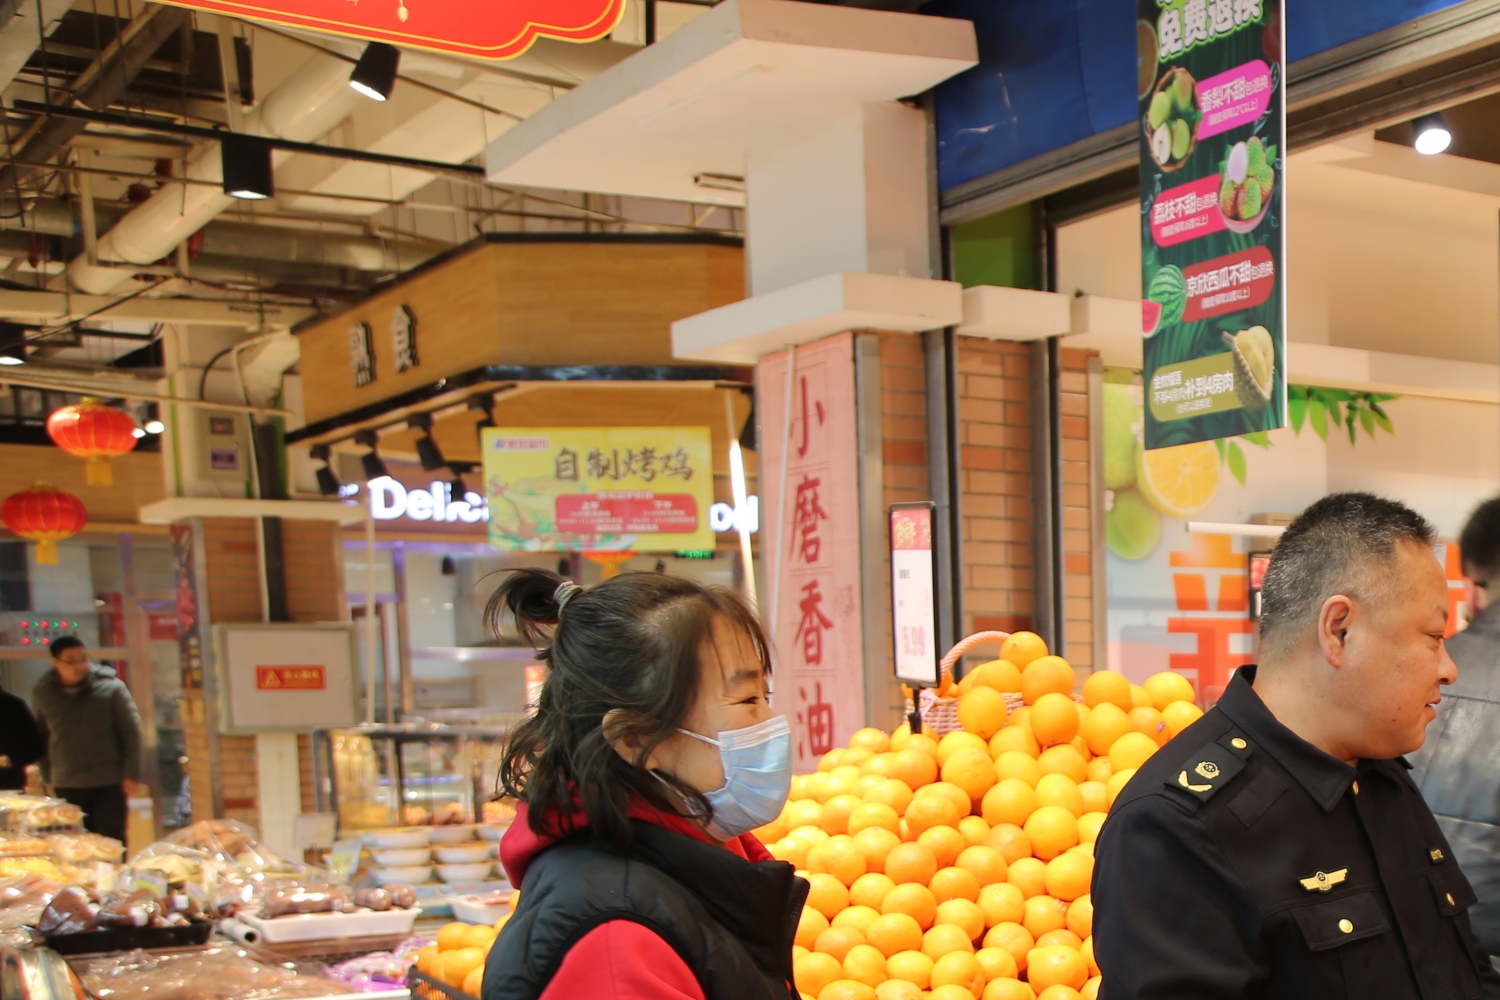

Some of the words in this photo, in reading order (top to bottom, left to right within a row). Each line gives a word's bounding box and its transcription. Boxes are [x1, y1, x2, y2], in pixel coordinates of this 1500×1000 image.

[553, 446, 696, 482] 自制烤鸡
[789, 373, 836, 762] 小磨香油
[902, 625, 926, 658] 5.99
